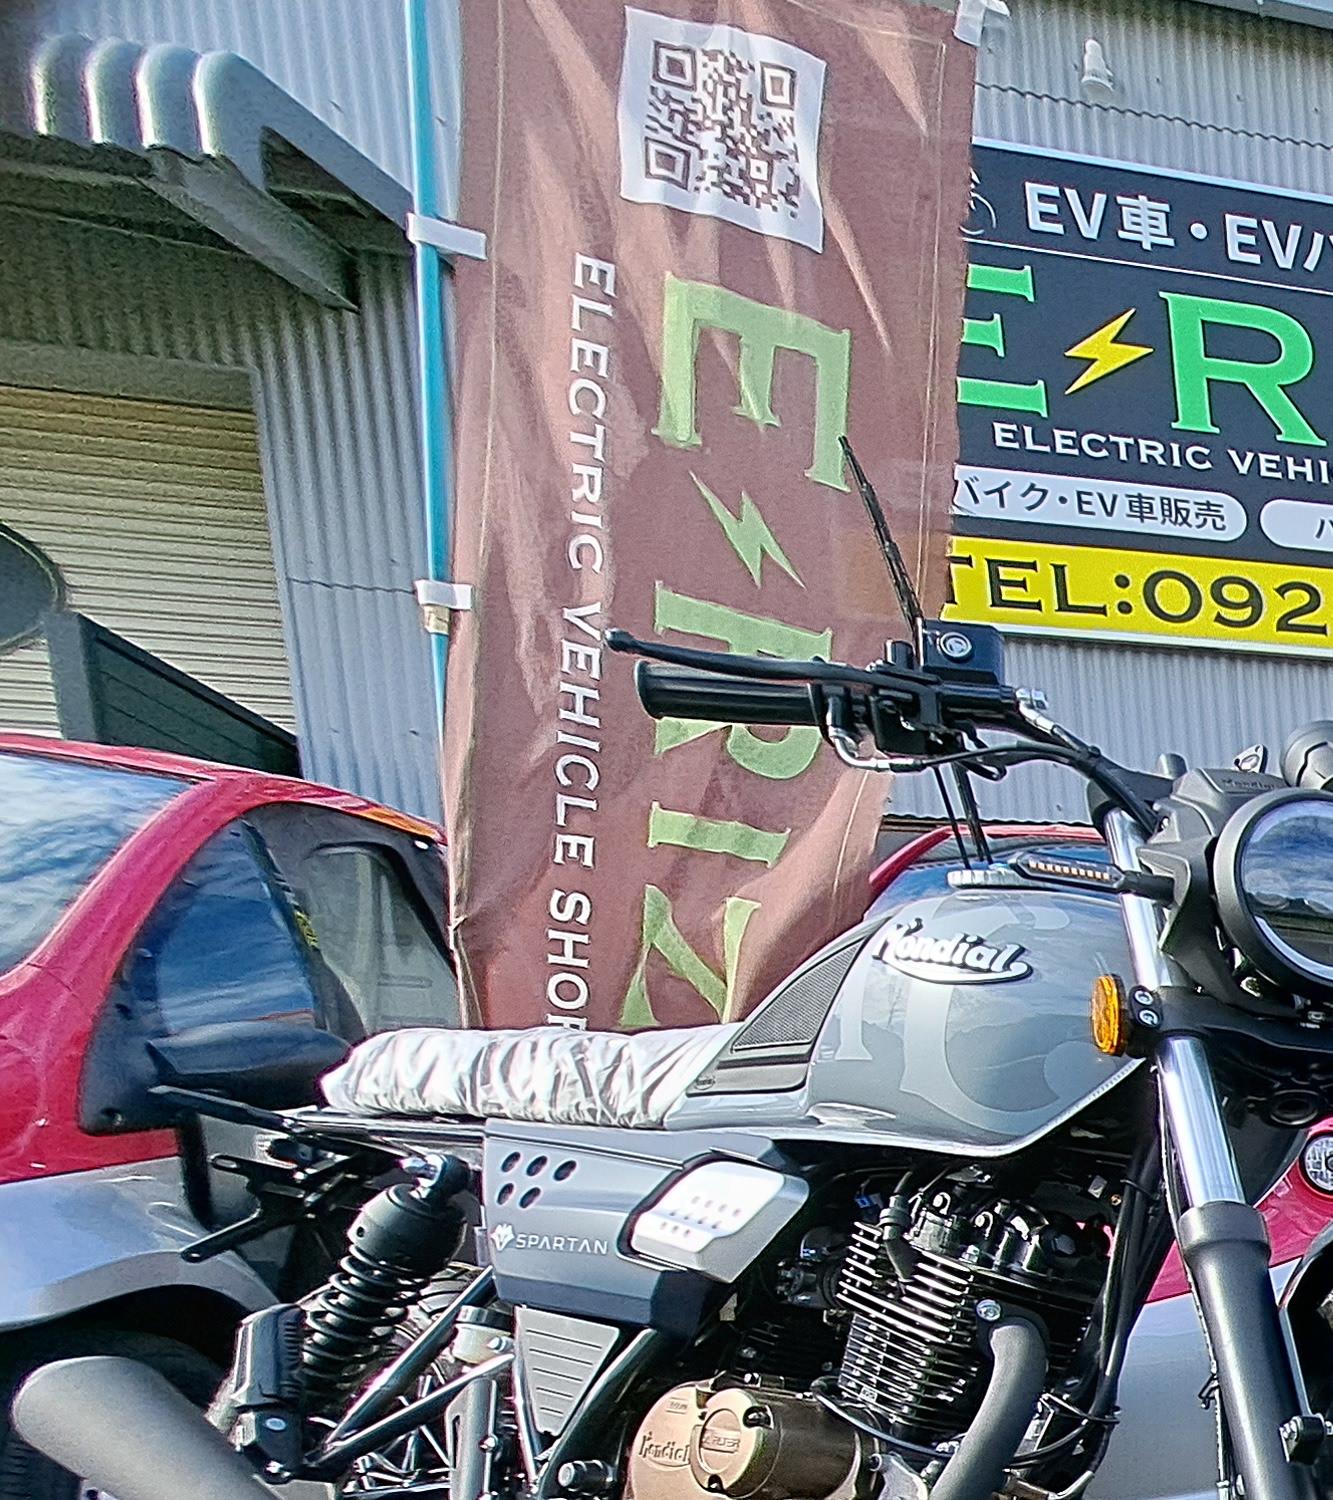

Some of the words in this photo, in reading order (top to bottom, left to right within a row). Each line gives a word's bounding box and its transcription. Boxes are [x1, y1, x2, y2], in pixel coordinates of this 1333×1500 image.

[566, 252, 617, 574] ELECTRIC
[650, 271, 851, 492] E
[993, 422, 1213, 471] ELECTRIC
[553, 600, 605, 870] VEHICLE
[872, 918, 1031, 981] Mondial
[515, 1232, 608, 1256] SPARTAN
